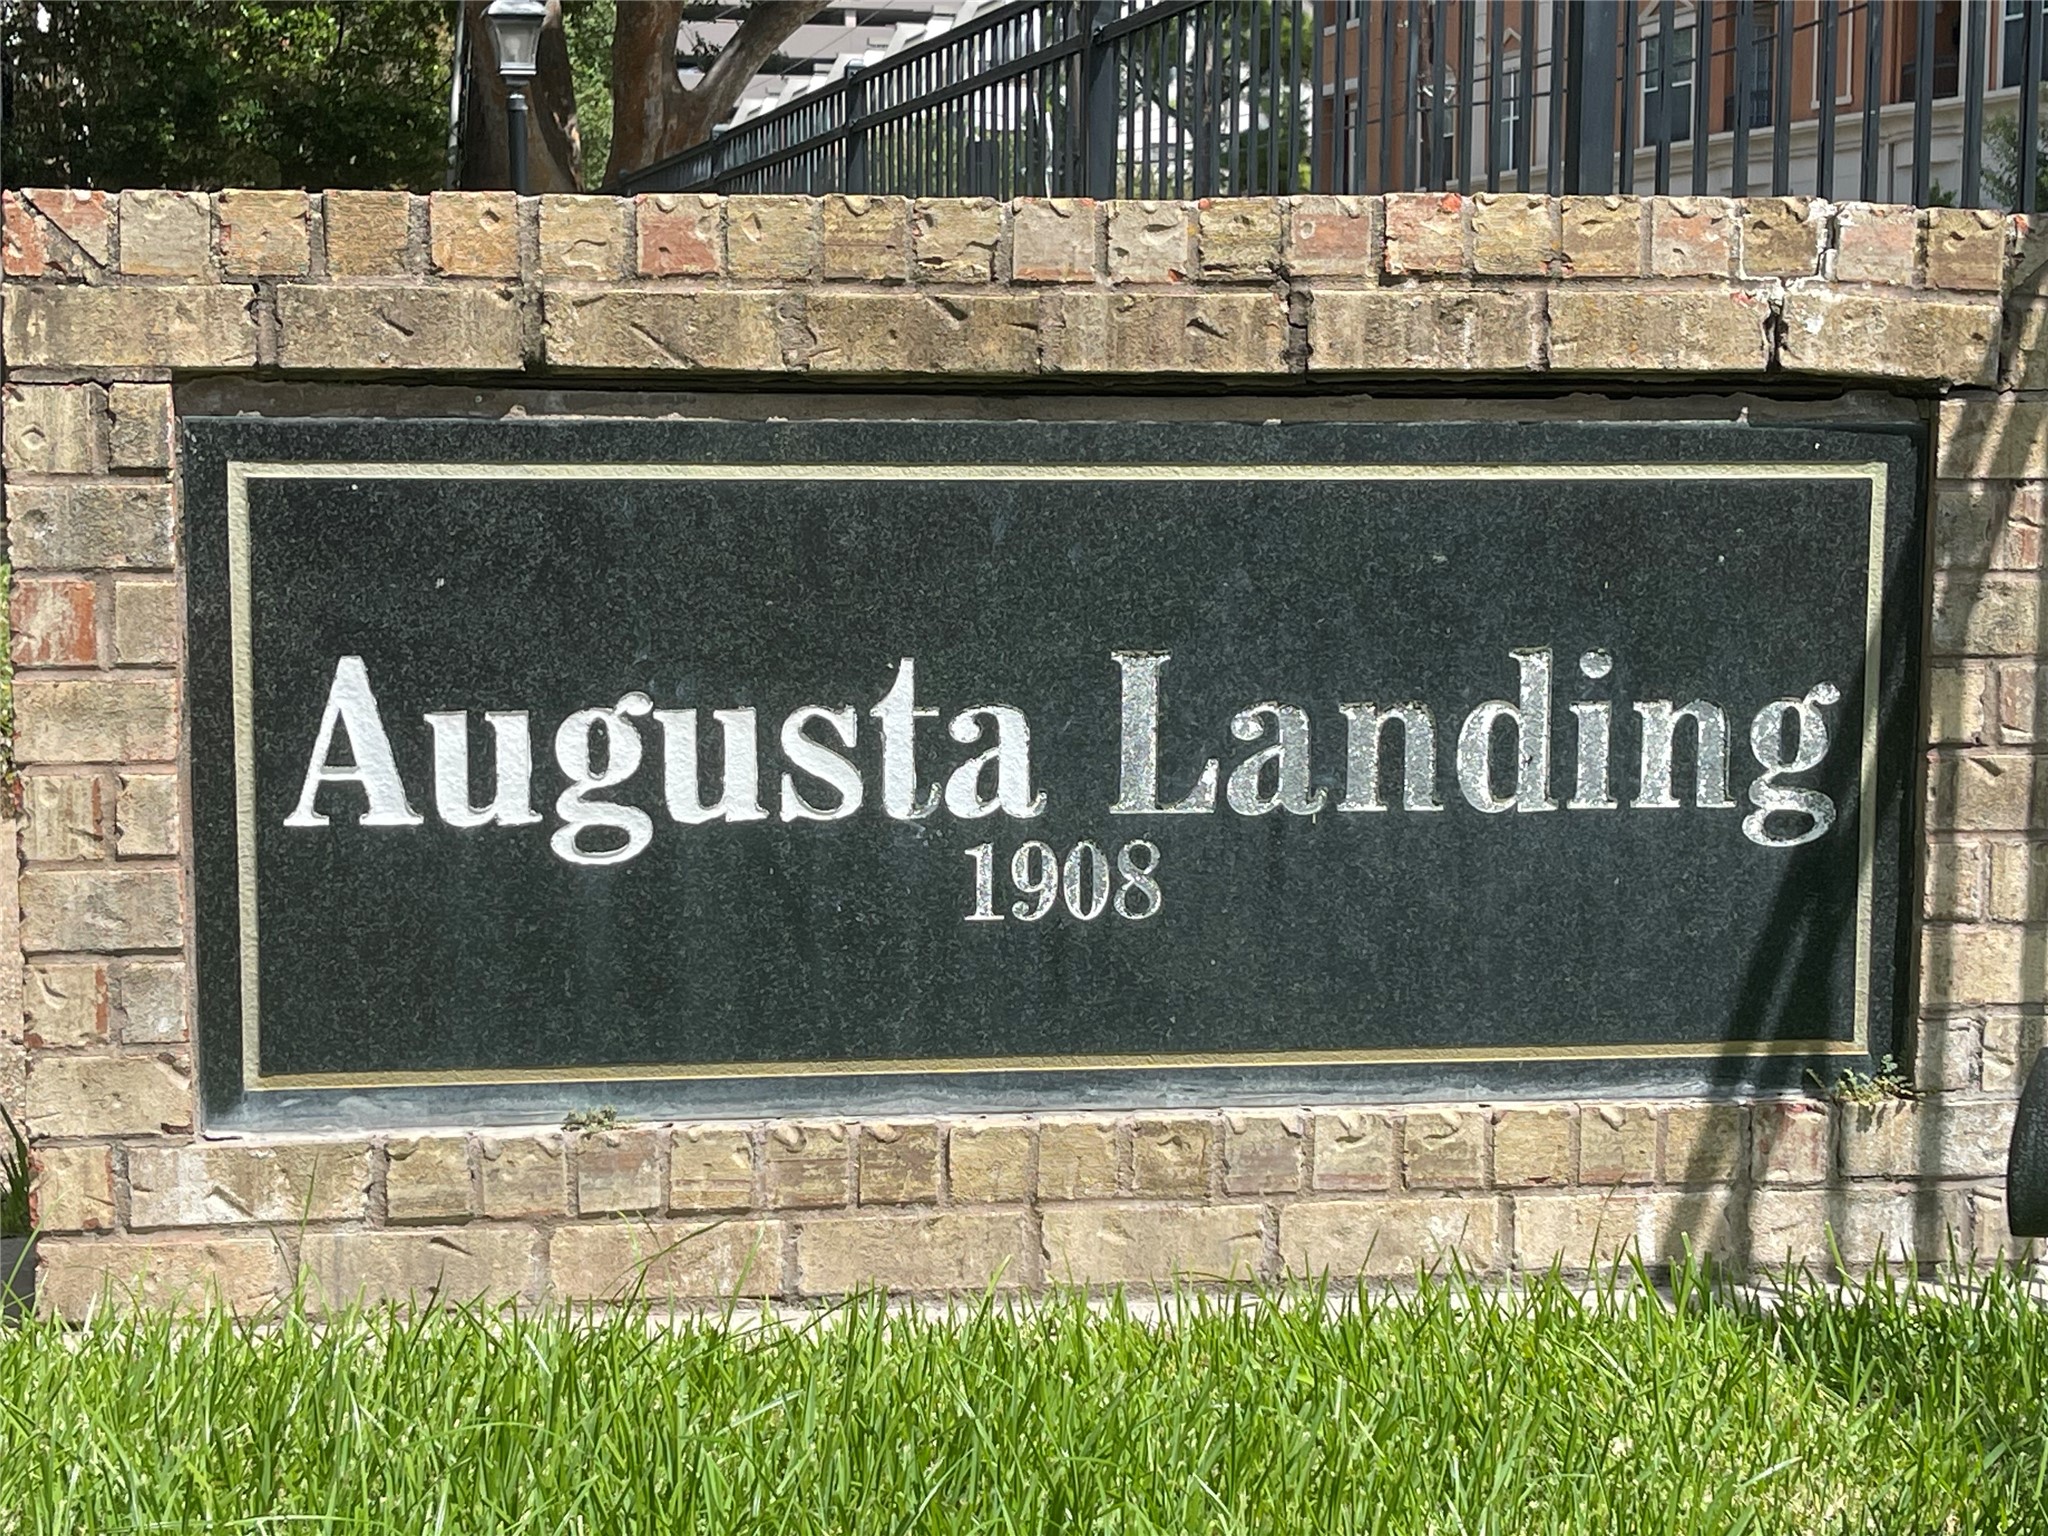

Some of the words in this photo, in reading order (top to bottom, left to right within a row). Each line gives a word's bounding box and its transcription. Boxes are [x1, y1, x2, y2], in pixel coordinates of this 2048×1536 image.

[283, 656, 1047, 868] Augusta
[1109, 648, 1840, 849] Landing
[963, 839, 1163, 923] 1908
